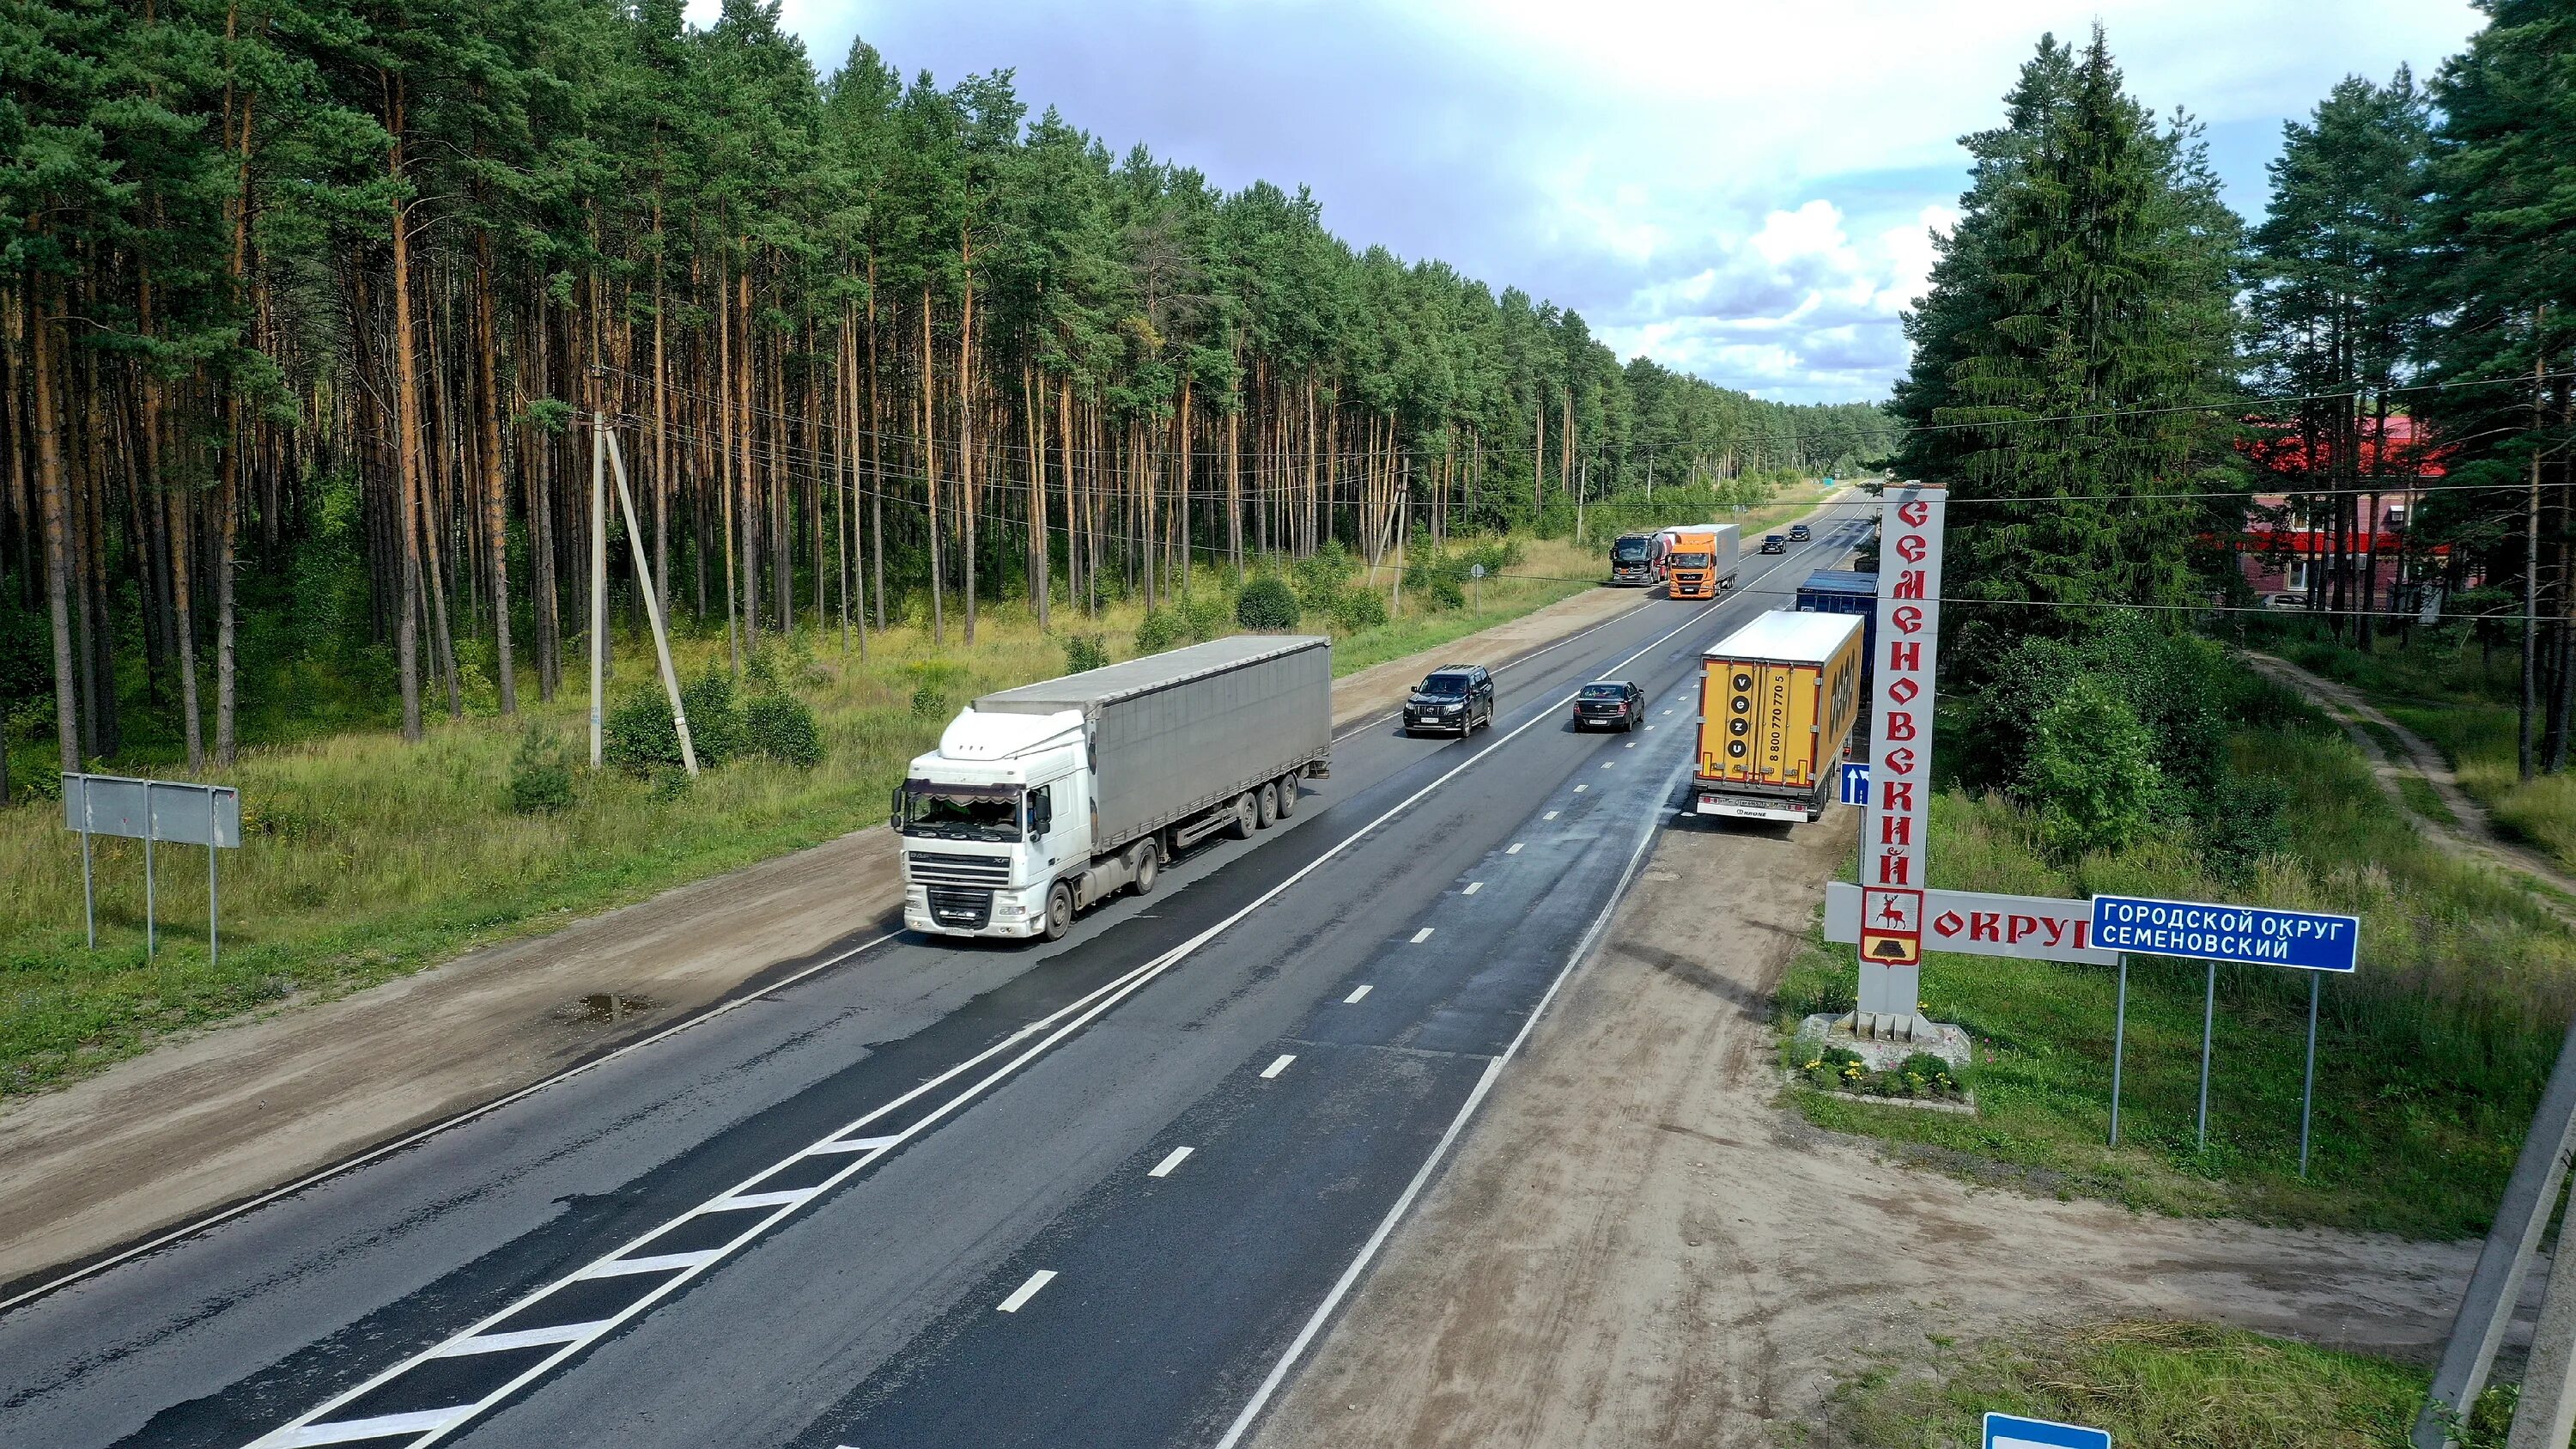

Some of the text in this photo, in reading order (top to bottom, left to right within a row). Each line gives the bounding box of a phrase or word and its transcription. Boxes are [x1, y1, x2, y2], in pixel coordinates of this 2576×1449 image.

[1773, 685, 1783, 705] 770
[1879, 499, 1929, 886] СЕМЕНОВСКИЙ
[1772, 709, 1782, 728] 770
[1771, 732, 1780, 752] 800
[1933, 910, 2091, 949] ОКРУГ
[2104, 902, 2344, 941] ГОРОДСКОЙ ОКРУГ
[2103, 926, 2289, 960] СЕМЕНОВСКИЙ
